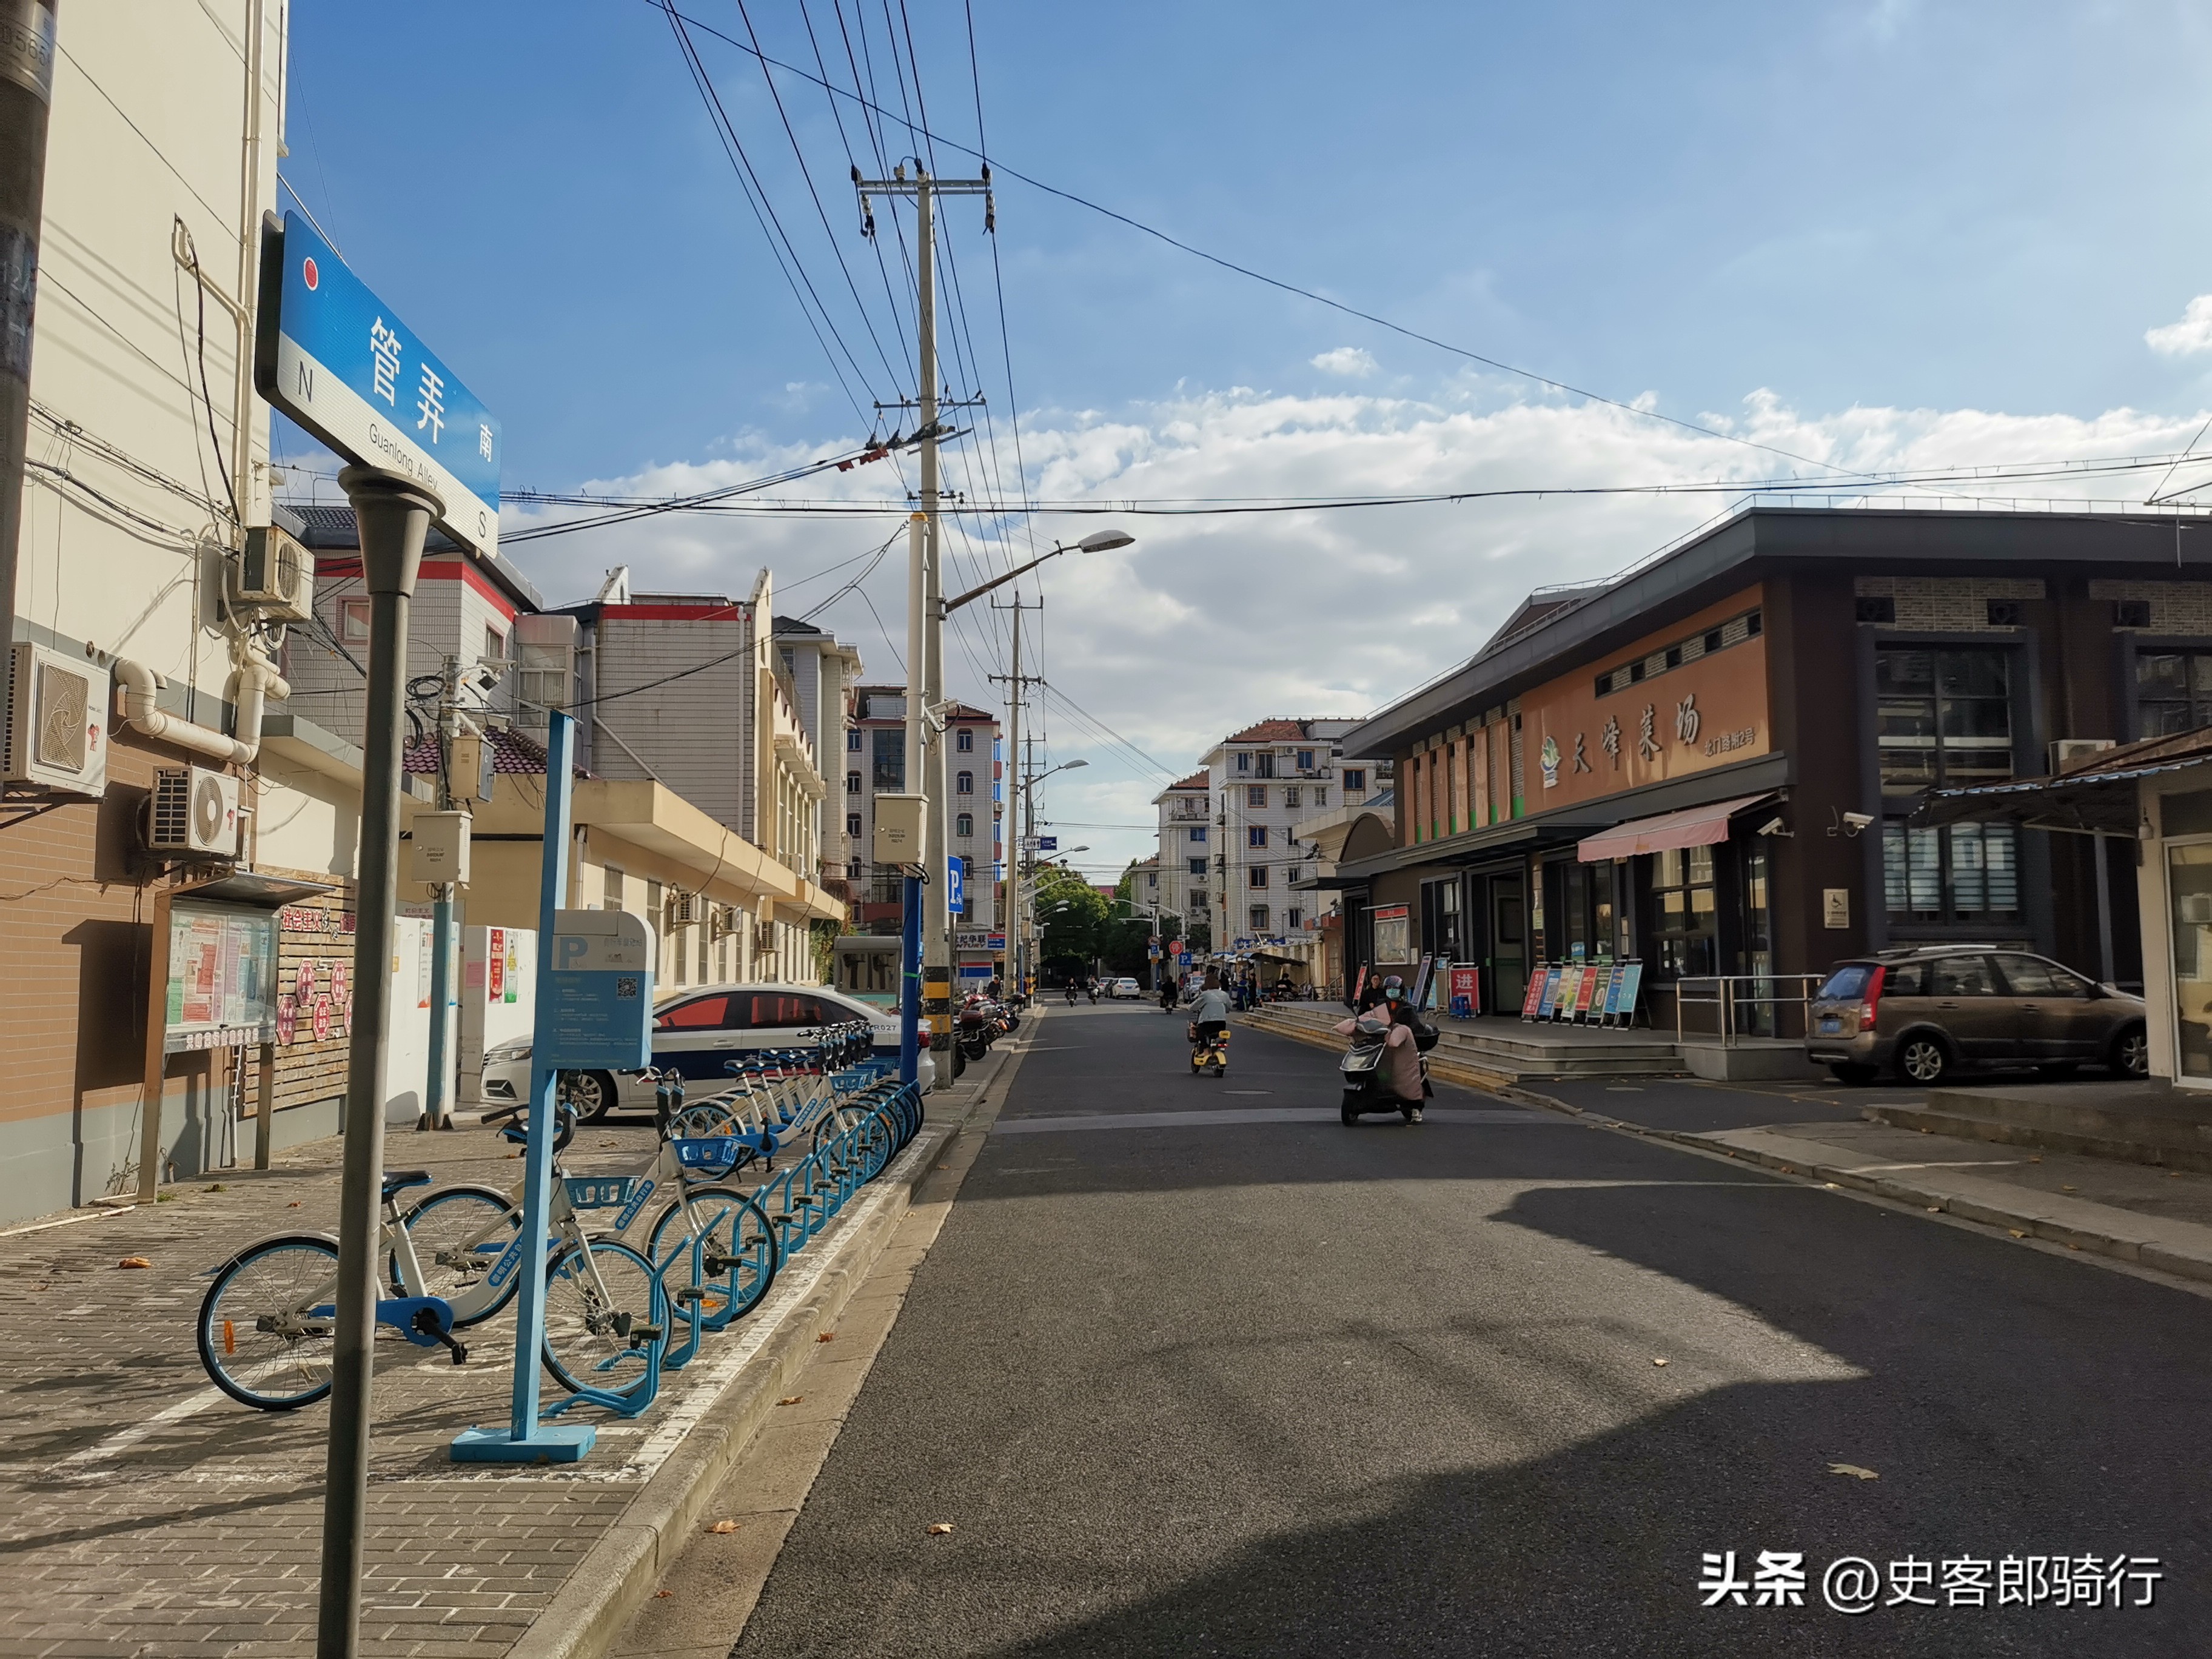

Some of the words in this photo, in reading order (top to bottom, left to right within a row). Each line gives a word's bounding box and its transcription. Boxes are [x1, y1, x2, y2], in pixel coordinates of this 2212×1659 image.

[298, 361, 313, 403] N
[370, 315, 444, 444] 管弄
[479, 423, 494, 463] 南
[369, 423, 413, 477] Guanlong
[417, 463, 438, 490] Alley
[477, 511, 487, 538] S
[1573, 693, 1700, 774] 天峰菜场
[950, 870, 959, 904] P
[558, 937, 588, 969] P
[956, 934, 986, 944] 纪华联
[491, 1236, 523, 1283] 崇明公共自
